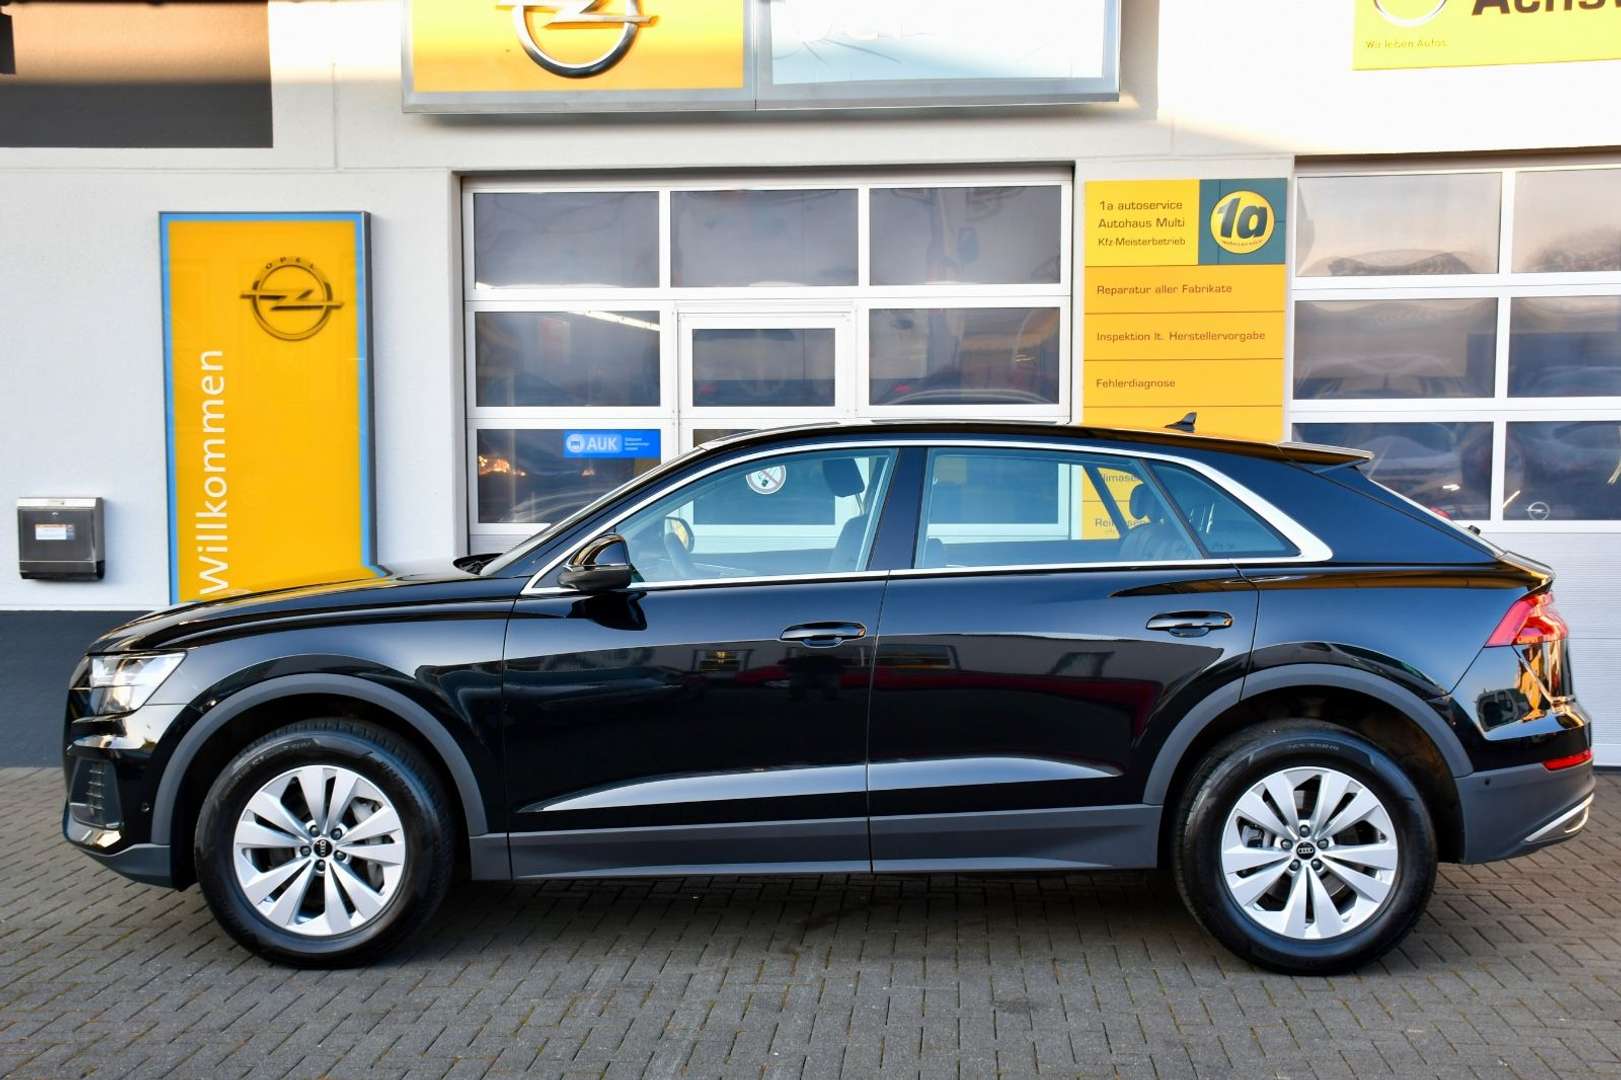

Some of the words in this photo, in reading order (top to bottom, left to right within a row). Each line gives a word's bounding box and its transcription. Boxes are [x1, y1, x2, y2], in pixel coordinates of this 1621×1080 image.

[1099, 200, 1114, 211] 1a
[1117, 200, 1183, 211] autoservice
[1098, 218, 1152, 229] Autohaus
[1155, 217, 1185, 228] Multi
[1217, 198, 1268, 239] 1a
[1096, 284, 1152, 296] Reparatur
[1155, 284, 1178, 295] aller
[1182, 283, 1233, 294] Fabrikate
[1096, 332, 1151, 343] Inspektion
[1168, 330, 1266, 343] Herstellervorgabe
[1096, 378, 1176, 390] Fehlerdiagnose
[195, 348, 229, 596] Willkommen
